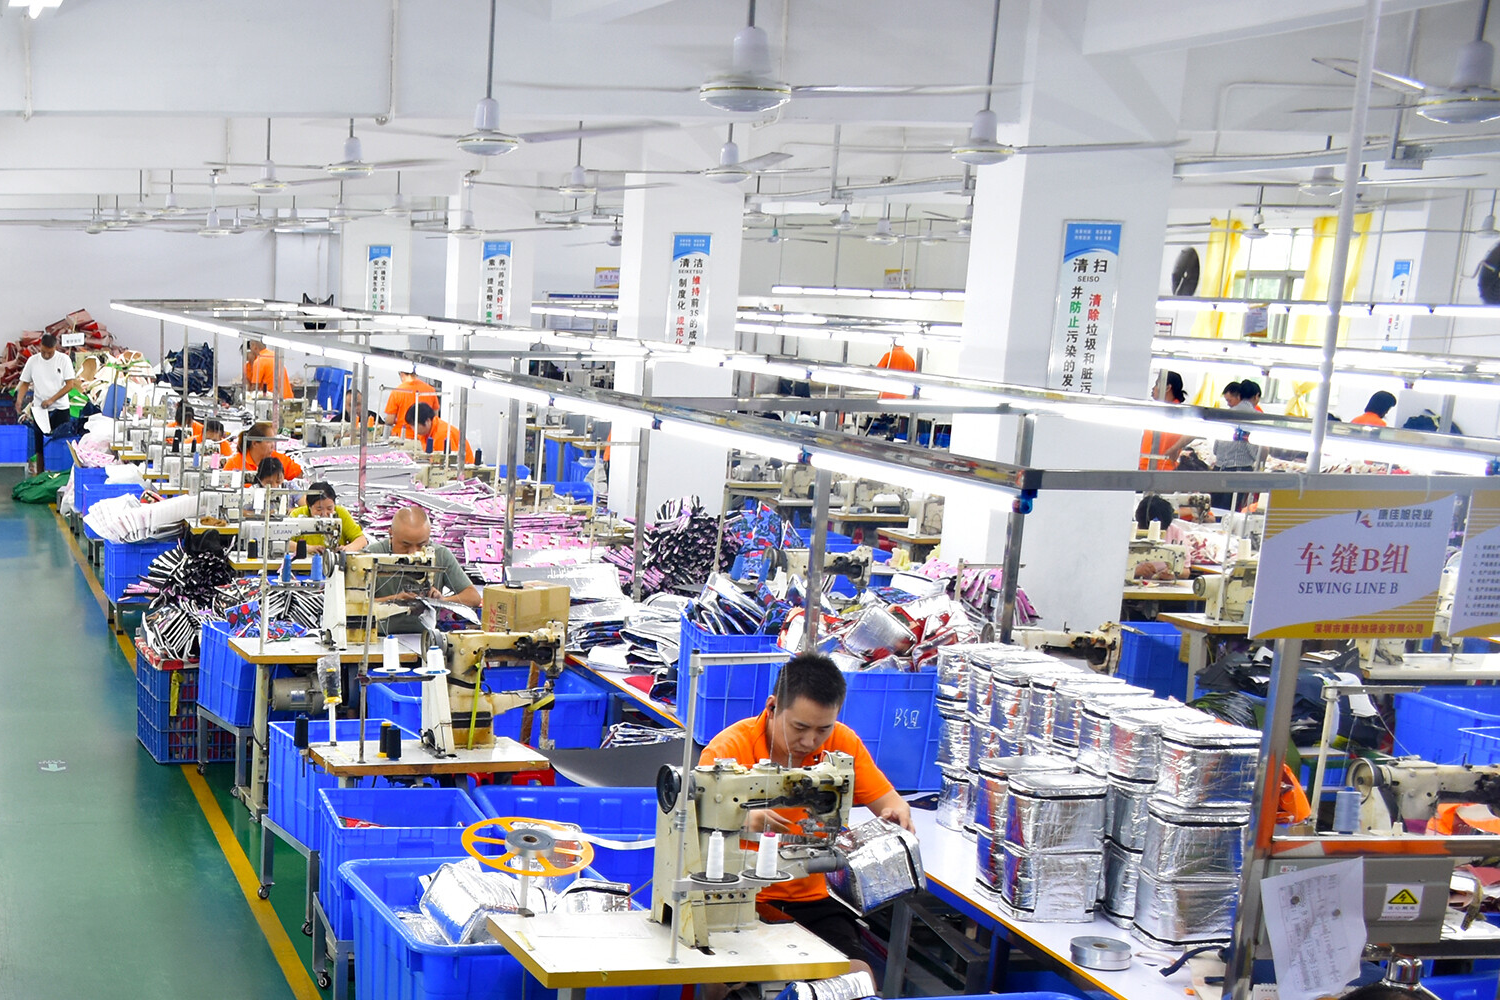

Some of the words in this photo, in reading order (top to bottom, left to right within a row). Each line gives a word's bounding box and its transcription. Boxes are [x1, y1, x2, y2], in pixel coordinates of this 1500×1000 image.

[1073, 258, 1108, 273] 清扫
[1061, 286, 1083, 391] 并防止污染的发
[1378, 508, 1433, 521] 康佳旭袋业
[1294, 542, 1410, 575] 车缝B组
[1297, 581, 1352, 595] SEWING
[1354, 581, 1386, 595] LINE
[1388, 581, 1399, 594] B
[1313, 623, 1424, 634] 深圳市康佳旭袋业有限公司
